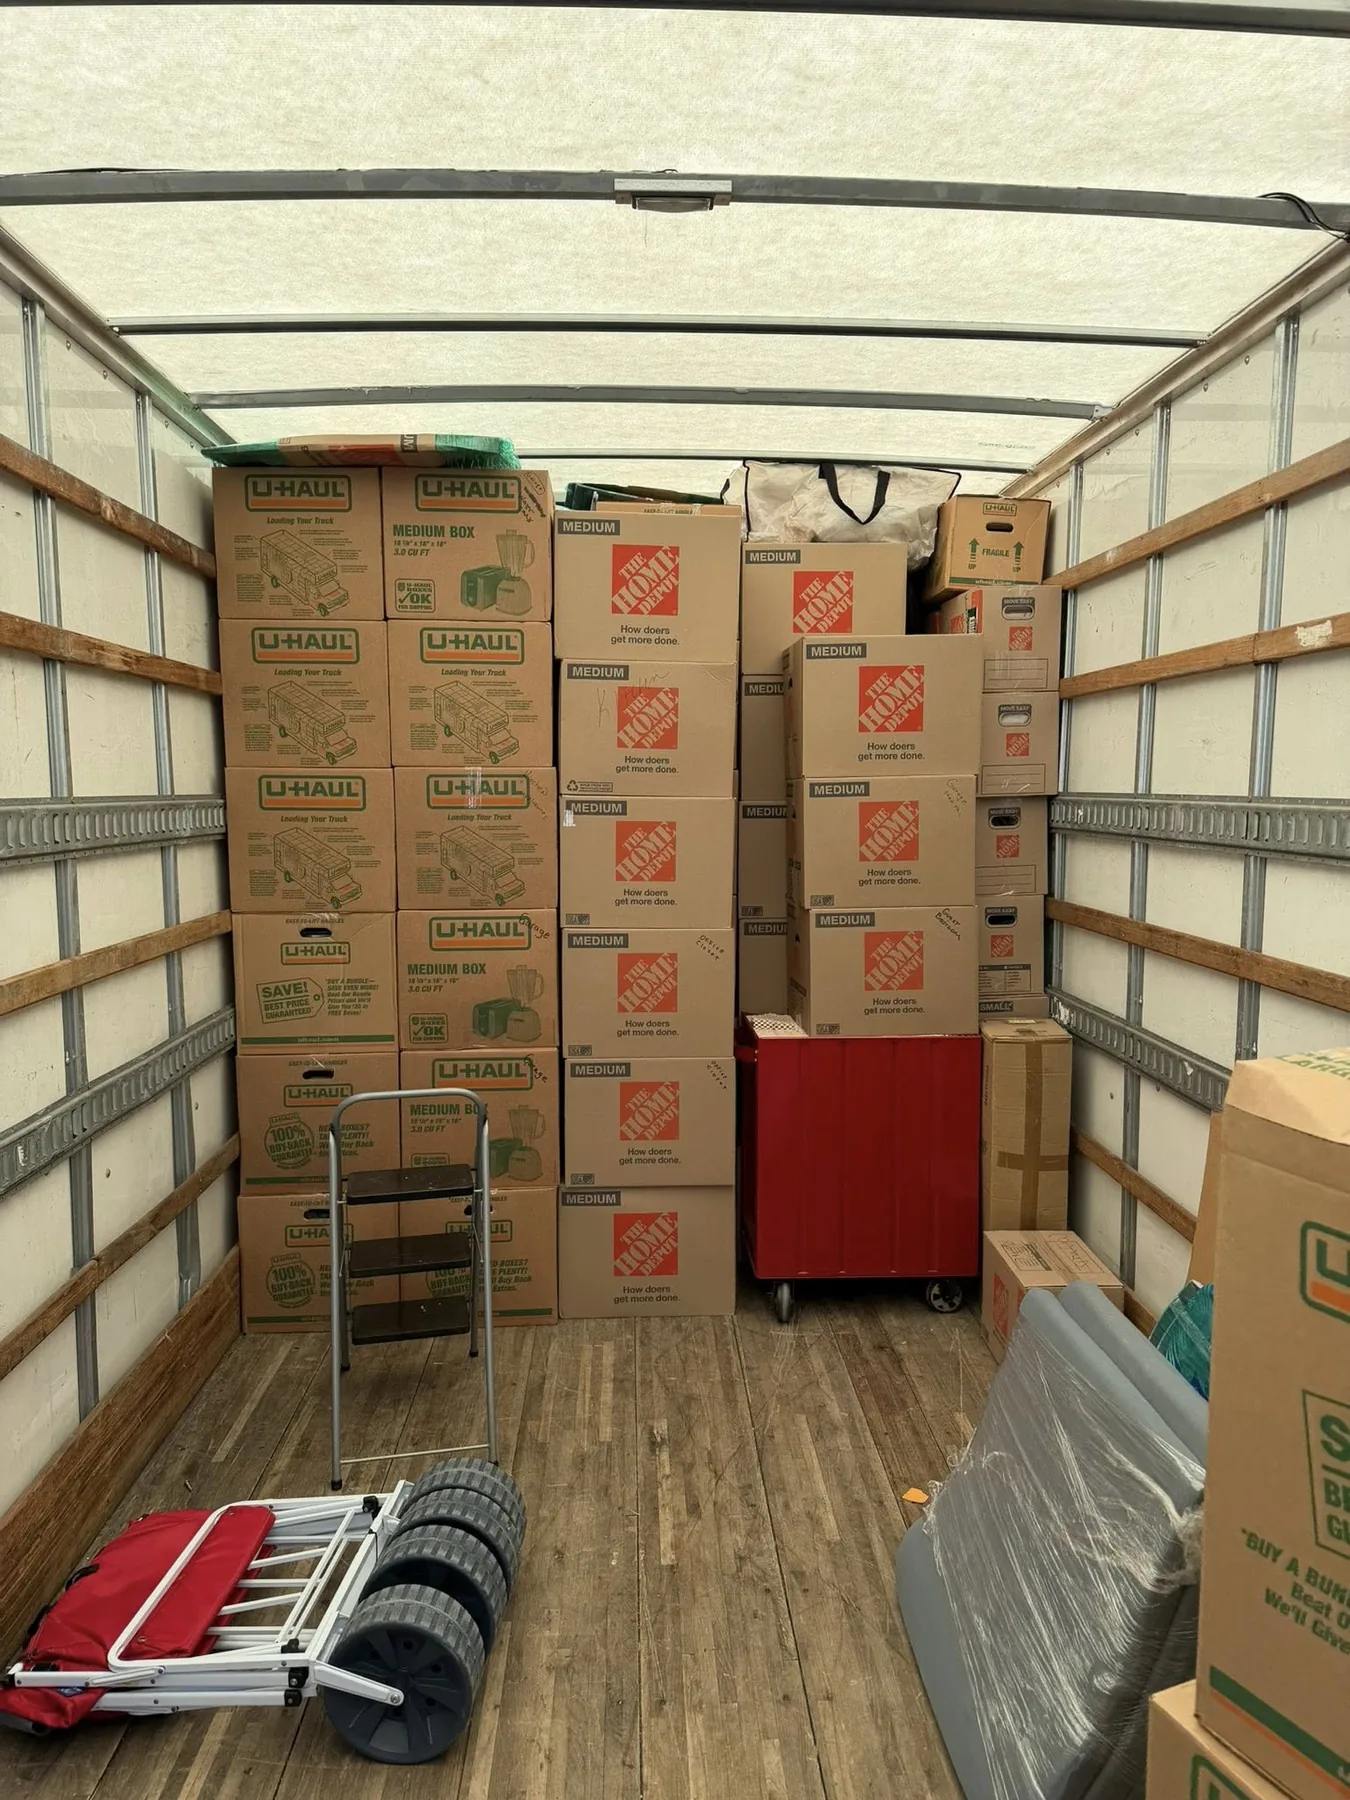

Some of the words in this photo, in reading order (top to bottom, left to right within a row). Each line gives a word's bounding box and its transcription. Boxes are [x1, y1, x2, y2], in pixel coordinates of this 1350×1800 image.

[252, 481, 345, 497] U-HAUL
[423, 481, 514, 498] U-HAUL
[985, 504, 1015, 512] U-HAUL
[267, 517, 294, 525] Loading
[563, 521, 615, 532] MEDIUM
[393, 525, 444, 537] MEDIUM
[450, 526, 475, 538] BOX
[750, 552, 796, 561] MEDIUM
[982, 549, 1009, 557] FRAGILE
[619, 552, 648, 580] THE
[612, 545, 680, 615] HOME
[638, 571, 680, 614] DEPOT
[799, 578, 825, 603] THE
[410, 594, 431, 604] OK
[793, 572, 853, 632] HOME
[816, 595, 853, 632] DEPOT
[644, 626, 670, 634] doers
[259, 633, 352, 649] U-HAUL
[427, 634, 517, 650] U-HAUL
[611, 636, 626, 644] get
[655, 637, 679, 645] done.
[811, 646, 862, 656] MEDIUM
[441, 669, 468, 677] Loading
[573, 667, 624, 677] MEDIUM
[750, 685, 783, 693] MEDIU
[865, 673, 893, 700] THE
[624, 694, 650, 719] THE
[858, 666, 924, 732] HOME
[617, 687, 679, 748] HOME
[883, 691, 924, 731] DEPOT
[641, 710, 679, 748] DEPOT
[646, 756, 669, 764] doers
[858, 753, 872, 761] get
[266, 781, 359, 797] U-HAUL
[434, 780, 523, 795] U-HAUL
[815, 785, 865, 794] MEDIUM
[572, 803, 622, 813] MEDIUM
[747, 808, 786, 816] MEDIU
[865, 808, 891, 832] THE
[859, 802, 919, 861] HOME
[622, 828, 648, 852] THE
[882, 824, 919, 860] DEPOT
[616, 822, 676, 881] HOME
[639, 844, 676, 880] DEPOT
[859, 878, 872, 886] get
[749, 924, 787, 932] MEDIU
[820, 915, 870, 925] MEDIUM
[436, 923, 524, 938] U-HAUL
[573, 936, 623, 945] MEDIUM
[285, 946, 346, 956] U-HAUL
[871, 937, 896, 961] THE
[408, 964, 457, 974] MEDIUM
[463, 963, 486, 974] BOX
[865, 931, 924, 990] HOME
[624, 960, 649, 983] THE
[887, 954, 924, 990] DEPOT
[262, 982, 308, 998] SAVE!
[618, 954, 677, 1012] HOME
[640, 976, 677, 1012] DEPOT
[265, 1002, 284, 1011] BEST
[286, 998, 309, 1008] PRICE
[980, 1002, 1011, 1011] SMALL
[424, 1026, 444, 1035] OK
[439, 1063, 526, 1078] U-HAUL
[575, 1065, 625, 1075] MEDIUM
[288, 1088, 348, 1098] U-HAUL
[626, 1088, 651, 1112] THE
[411, 1105, 459, 1115] MEDIUM
[620, 1082, 679, 1140] HOME
[642, 1104, 679, 1140] DEPOT
[270, 1124, 305, 1142] 100%
[269, 1138, 312, 1153] BUY-BACK
[567, 1195, 616, 1203] MEDIUM
[290, 1228, 329, 1239] U-HA
[620, 1219, 648, 1245] THE
[614, 1213, 678, 1276] HOME
[638, 1237, 678, 1275] DEPOT
[273, 1264, 306, 1281] 100%
[1286, 1557, 1299, 1576] A
[1291, 1582, 1332, 1619] Beat
